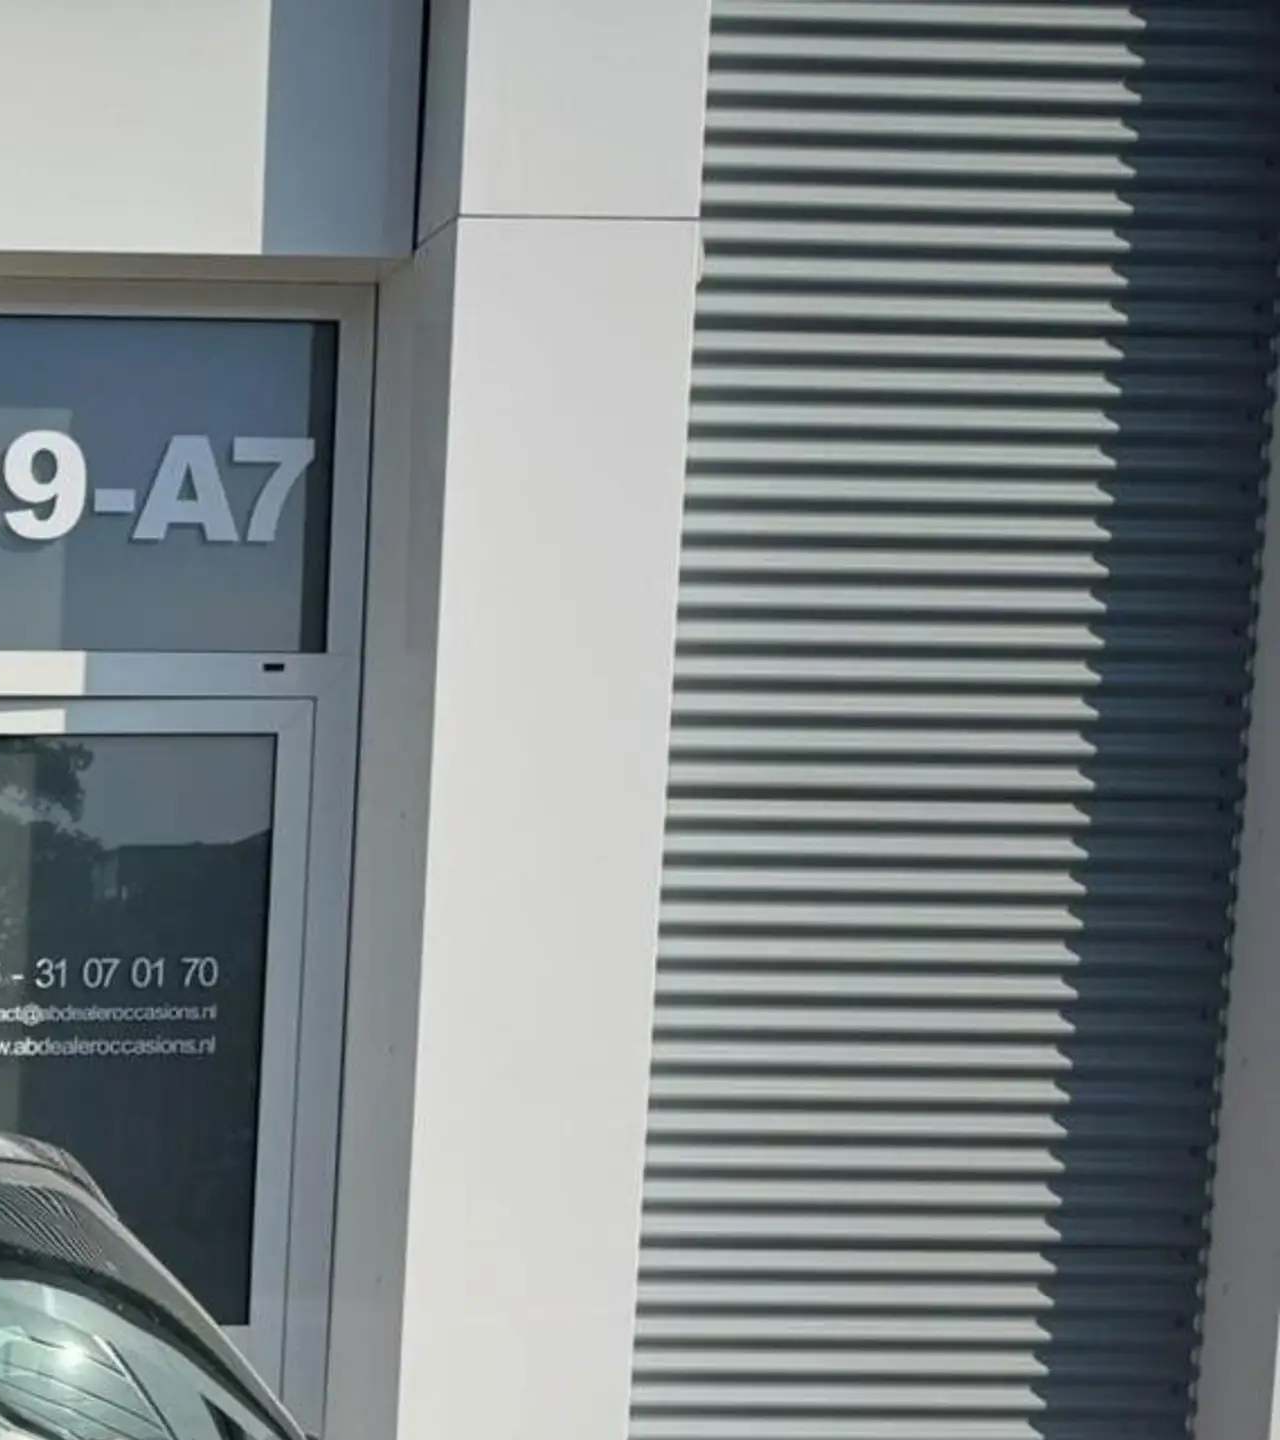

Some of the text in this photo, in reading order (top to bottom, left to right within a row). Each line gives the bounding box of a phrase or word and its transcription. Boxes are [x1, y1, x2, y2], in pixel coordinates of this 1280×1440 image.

[35, 957, 68, 989] 31
[82, 957, 122, 989] 07
[131, 956, 166, 988] 01
[181, 956, 219, 988] 70
